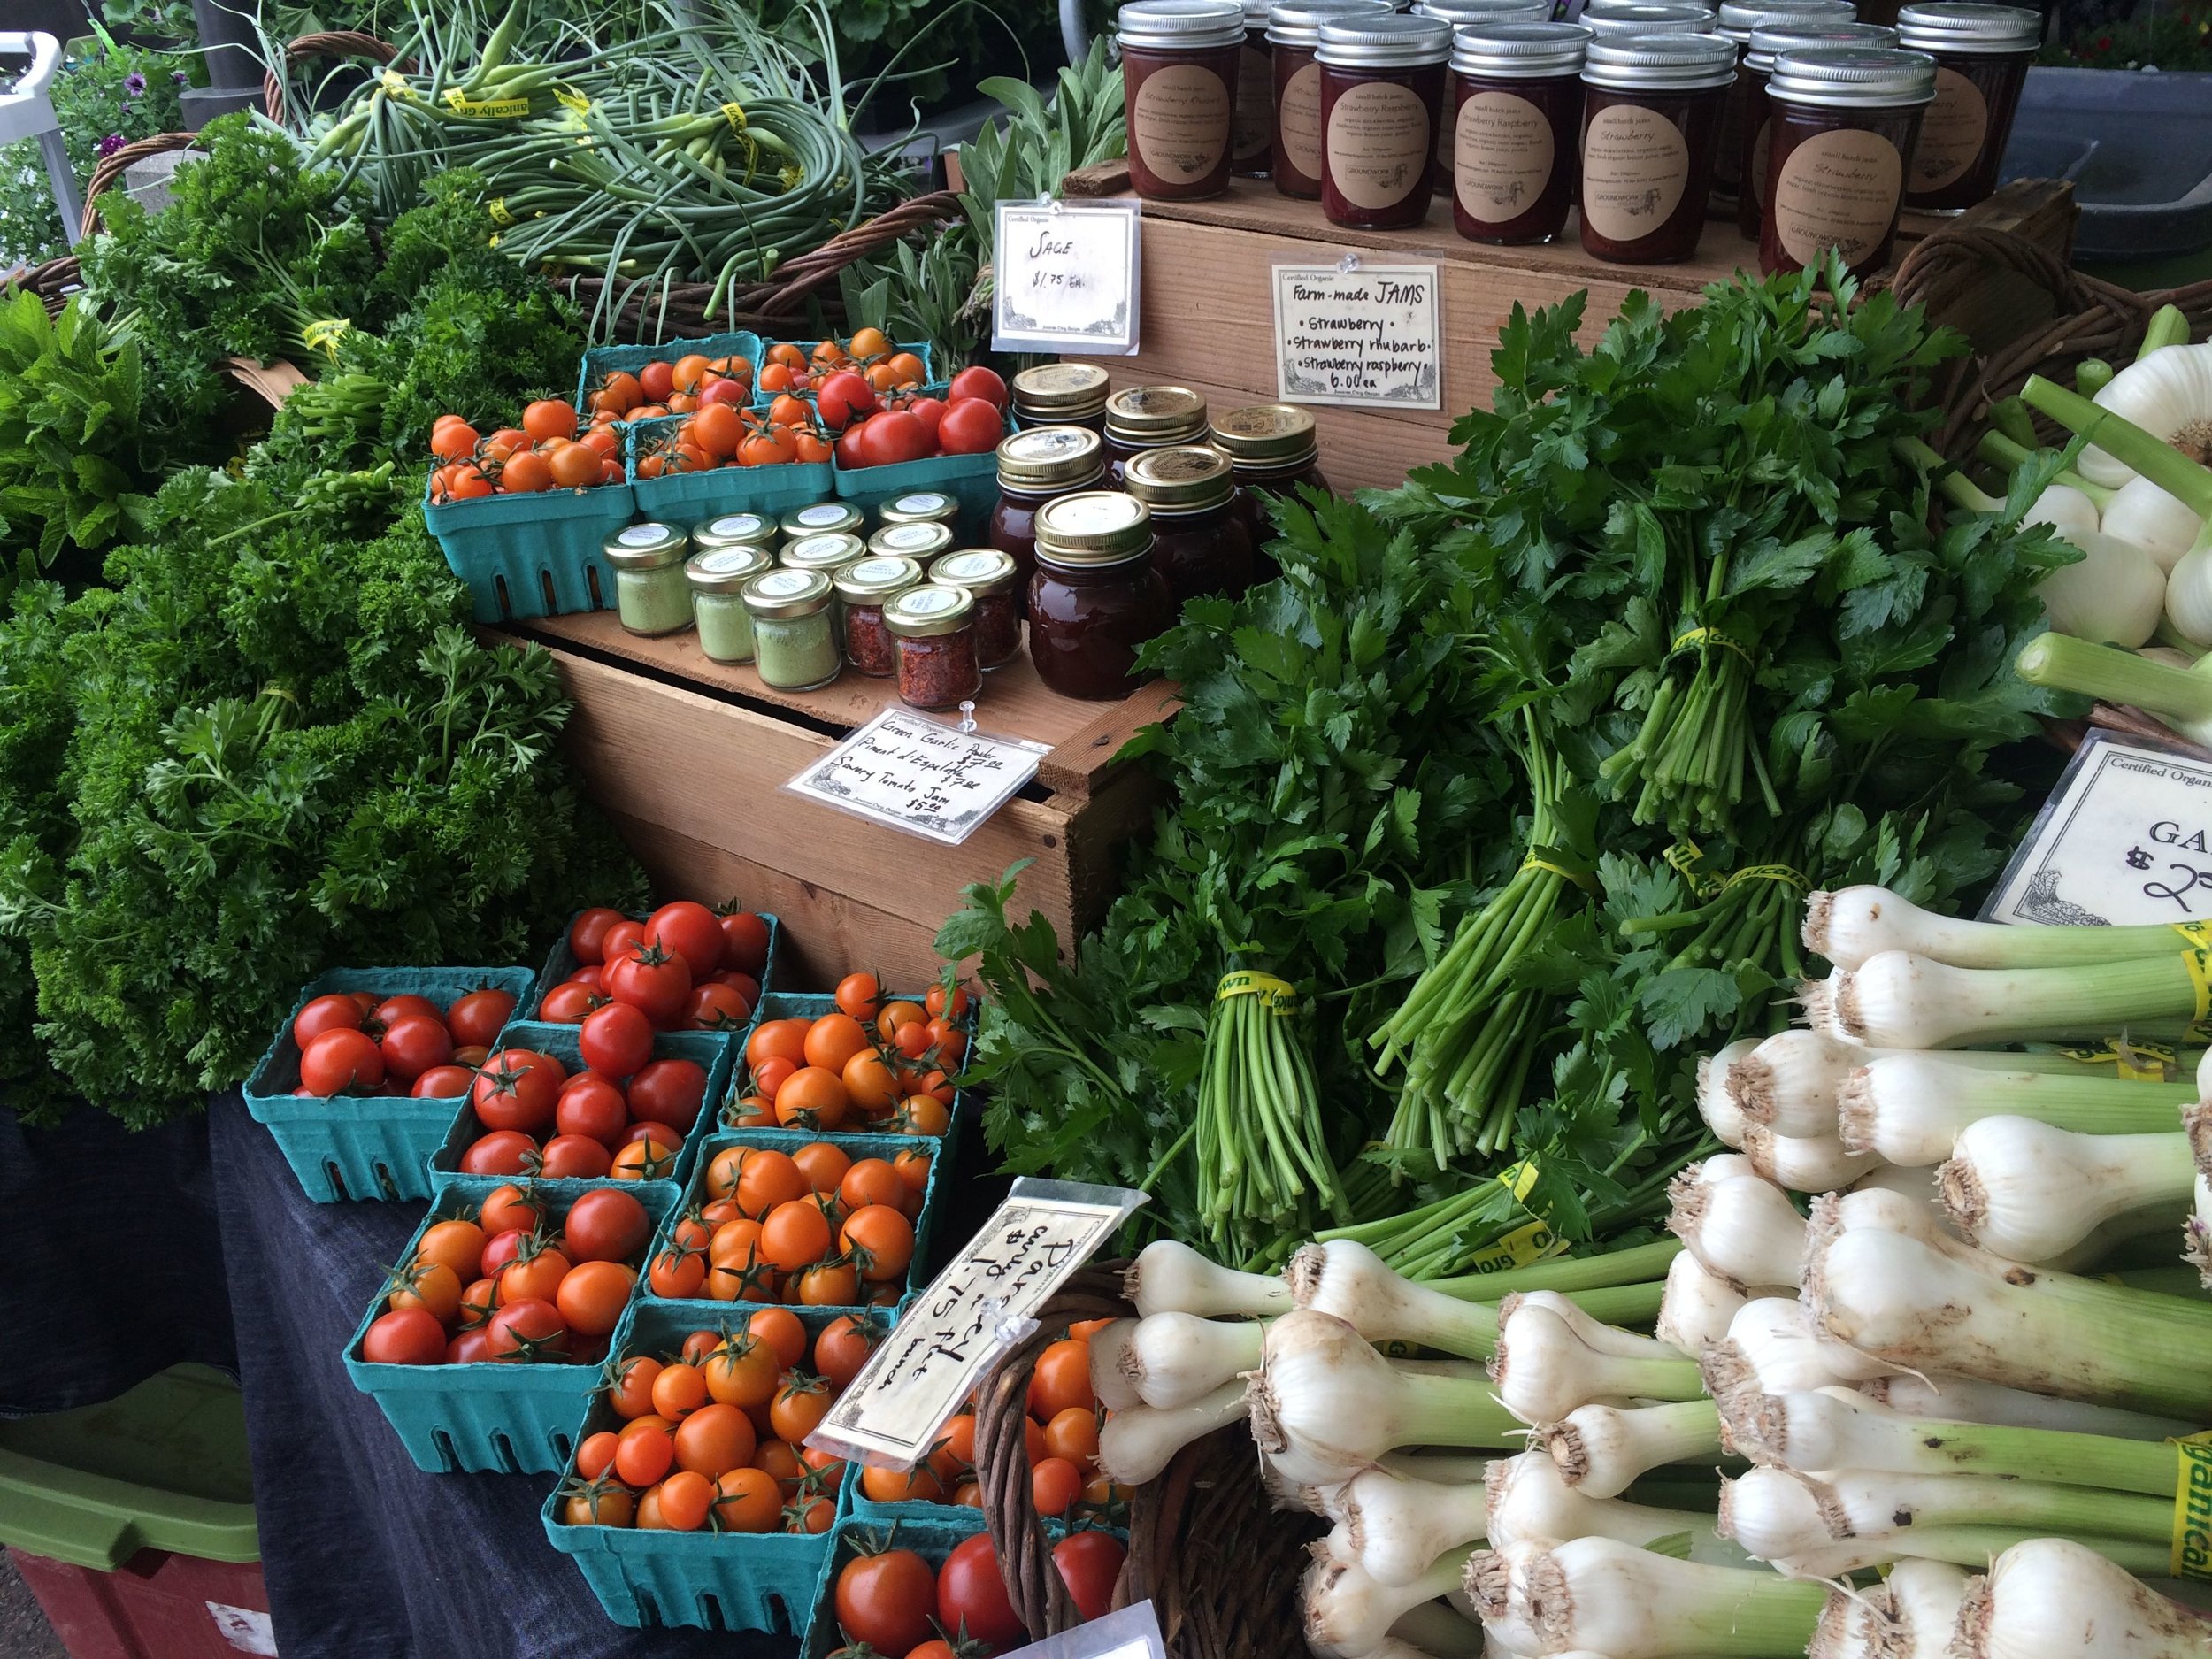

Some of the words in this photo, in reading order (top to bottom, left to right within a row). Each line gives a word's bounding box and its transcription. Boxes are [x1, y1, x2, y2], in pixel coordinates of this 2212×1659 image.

[1340, 102, 1379, 114] Strawberry
[1601, 130, 1656, 142] Strawberry
[1814, 163, 1878, 182] Strawberry
[1033, 270, 1064, 289] $1.75
[1310, 274, 1334, 283] Organic
[1375, 281, 1425, 306] JAMS
[1309, 317, 1384, 342] Strawberry
[1330, 372, 1360, 388] 6.00
[1363, 379, 1377, 388] ea
[857, 736, 895, 756] Piment
[880, 720, 914, 740] Green
[920, 733, 959, 751] Garlic
[830, 755, 877, 783] Savory
[878, 772, 917, 793] Tomato
[923, 786, 951, 805] Jam
[2110, 757, 2167, 778] Certified
[2170, 770, 2212, 787] Organ
[2148, 820, 2212, 856] GA
[986, 1225, 1048, 1282] curly
[877, 1338, 926, 1391] bunch
[912, 1326, 956, 1382] flat
